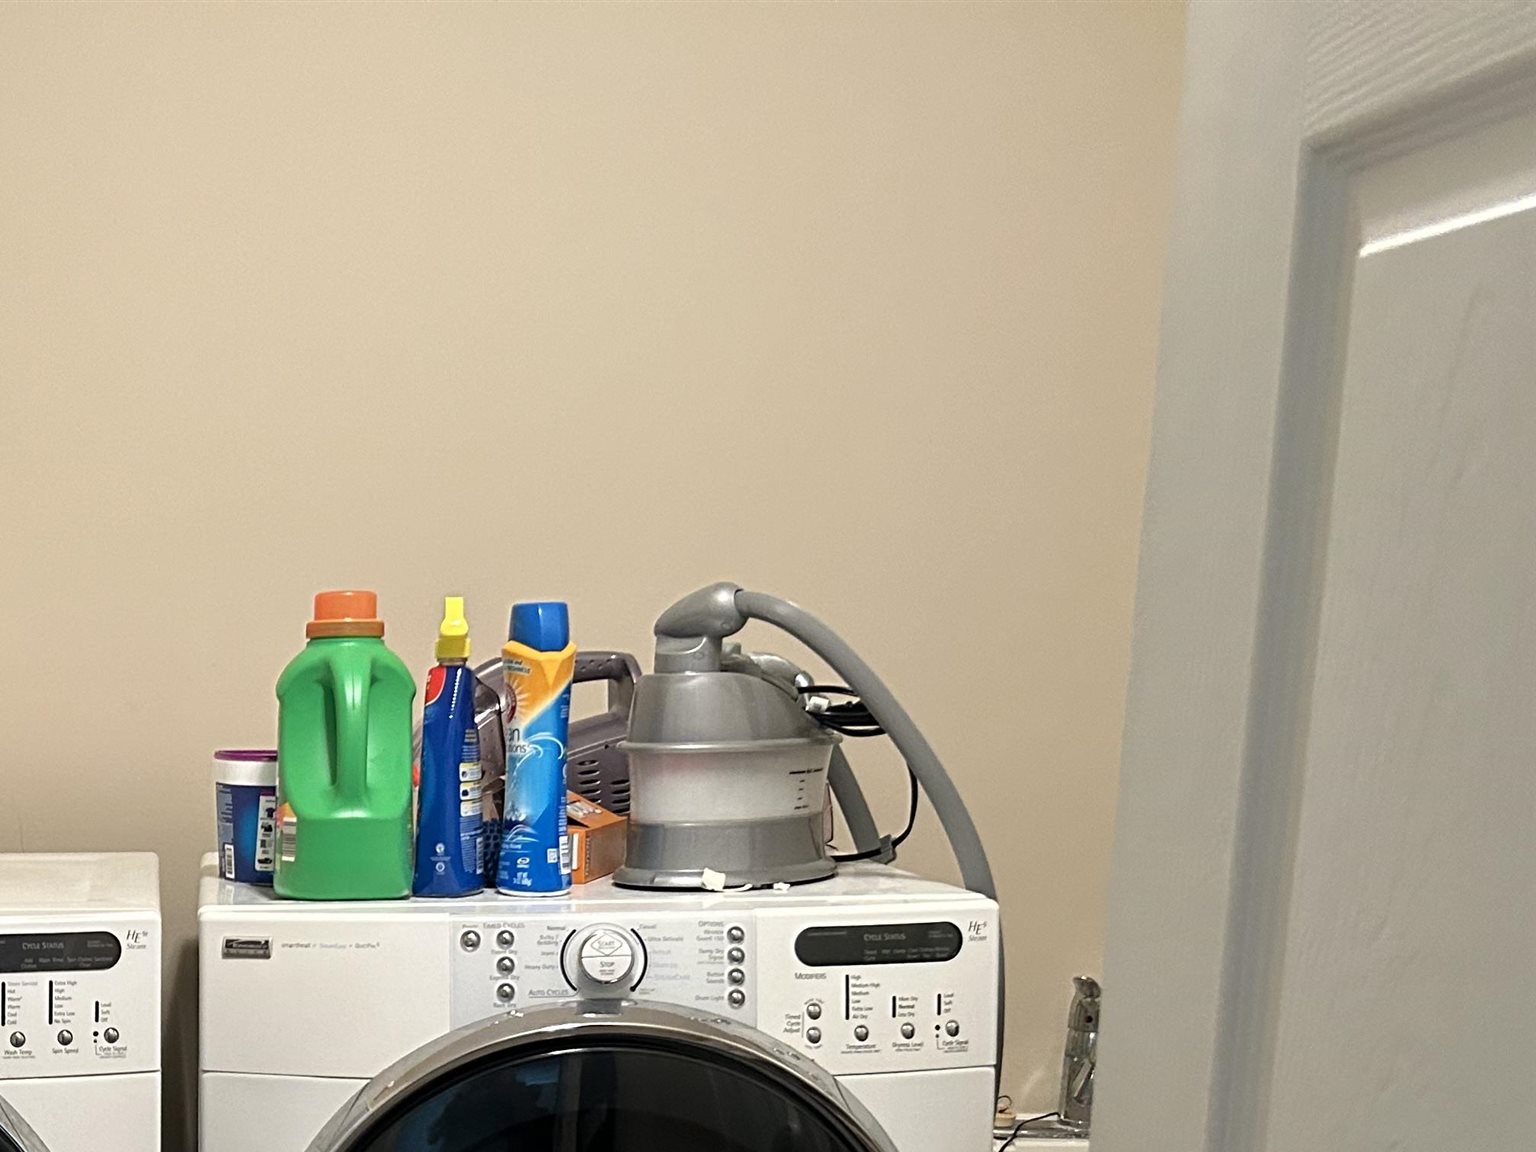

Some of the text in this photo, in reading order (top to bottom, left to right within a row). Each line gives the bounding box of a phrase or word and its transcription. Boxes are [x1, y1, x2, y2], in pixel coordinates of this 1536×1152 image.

[22, 941, 64, 950] CYCLE STATUS
[795, 972, 827, 980] MODIFIERS
